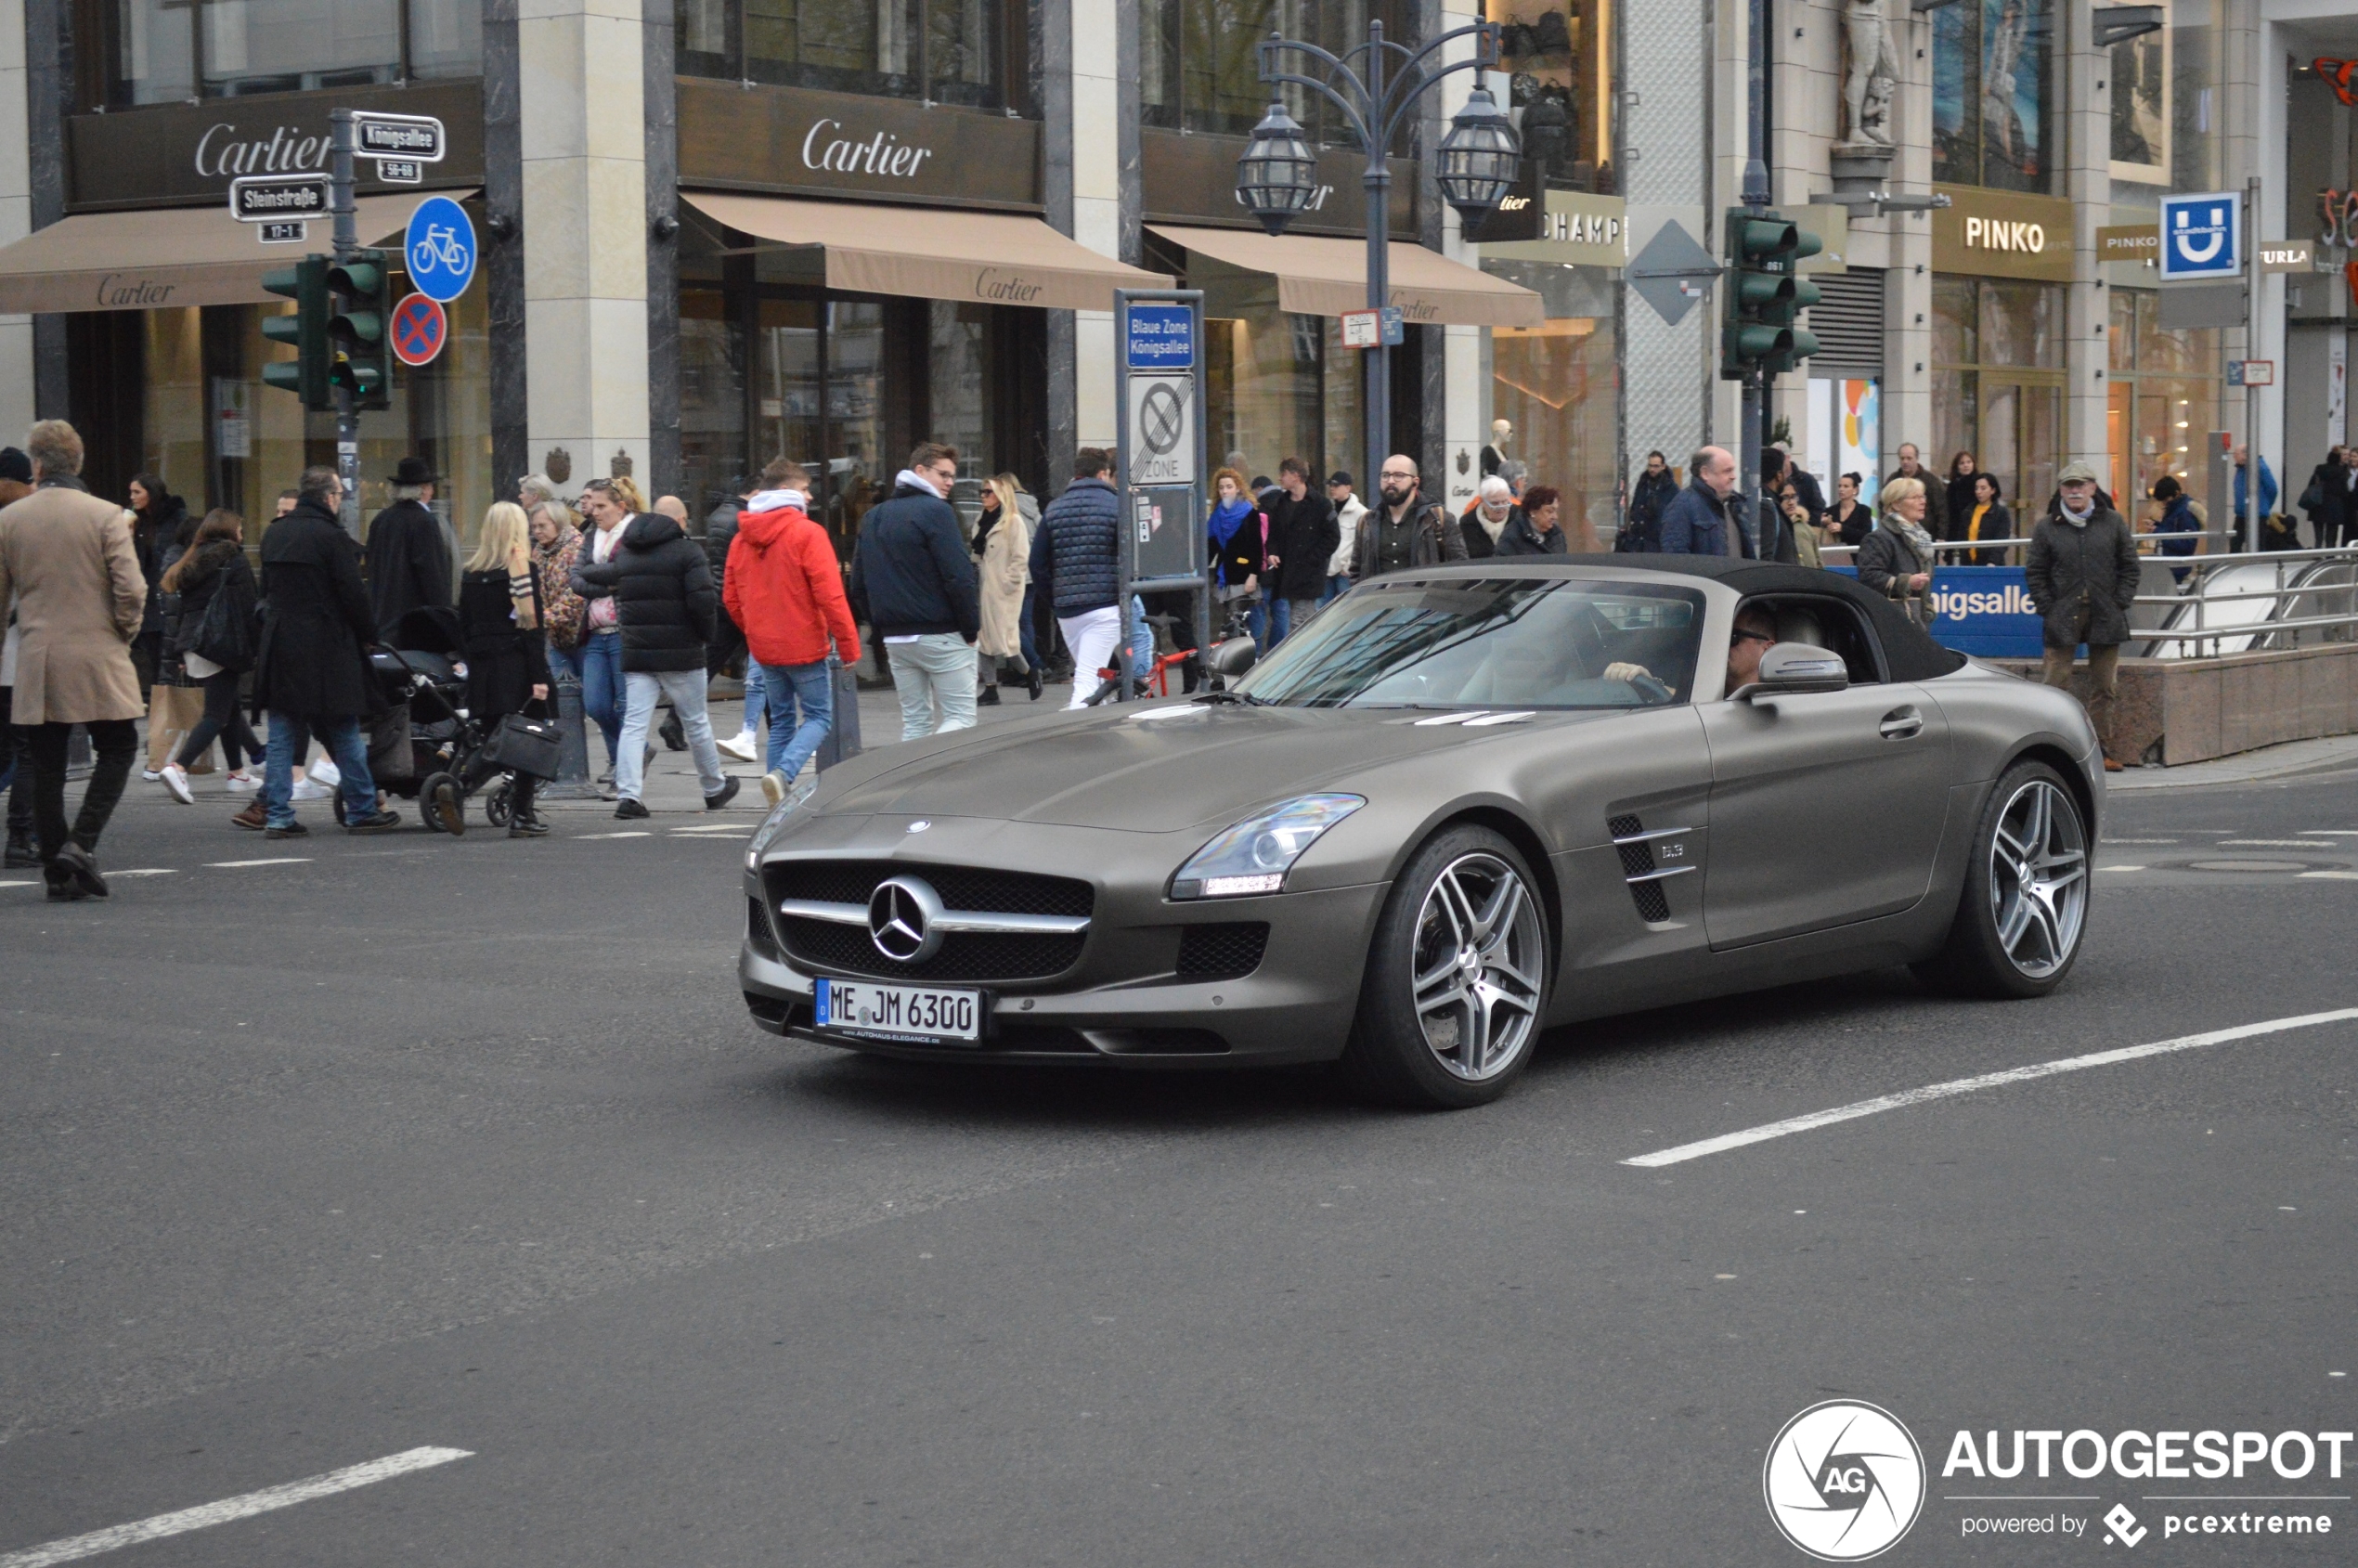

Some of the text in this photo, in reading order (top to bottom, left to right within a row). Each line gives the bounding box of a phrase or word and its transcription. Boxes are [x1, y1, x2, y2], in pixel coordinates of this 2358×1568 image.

[367, 126, 433, 149] Königsallee
[803, 119, 931, 176] Cartier
[195, 123, 331, 176] Cartier
[387, 163, 413, 176] 56-68
[244, 188, 317, 209] Steinstraße
[1499, 195, 1530, 211] tier
[271, 225, 293, 238] 17-1
[1966, 216, 2044, 253] PINKO
[2106, 236, 2158, 249] PINKO
[97, 273, 175, 306] Cartier
[976, 266, 1042, 302] Cartier
[1131, 318, 1188, 334] Blaue Zone
[1130, 339, 1190, 358] Königsallee
[1145, 460, 1179, 478] ZONE
[1930, 584, 2037, 621] nigsalle
[830, 985, 973, 1031] ME JM 6300
